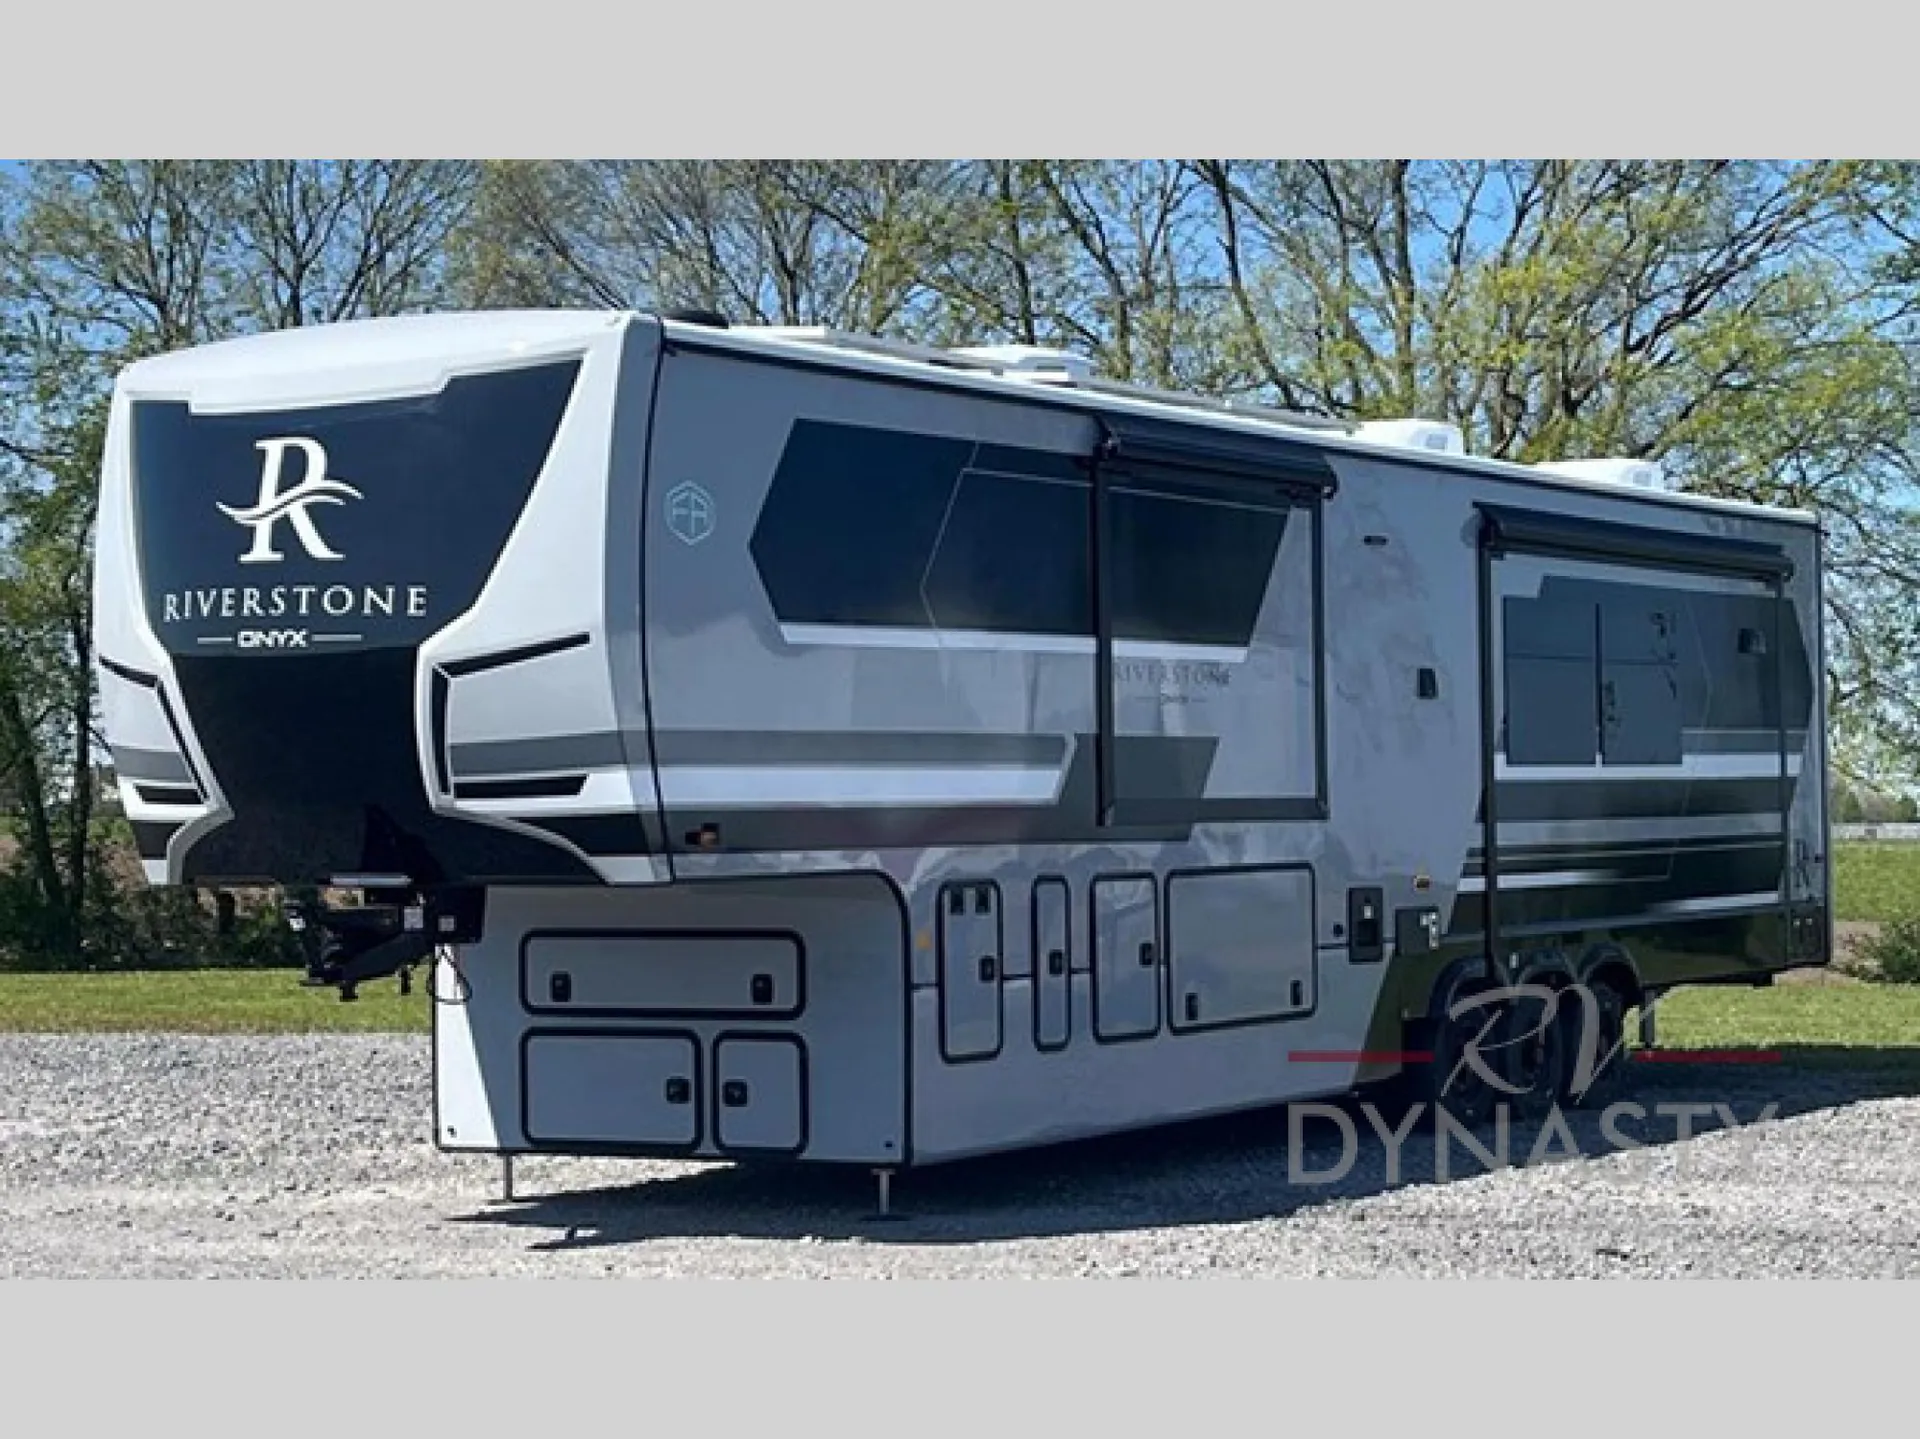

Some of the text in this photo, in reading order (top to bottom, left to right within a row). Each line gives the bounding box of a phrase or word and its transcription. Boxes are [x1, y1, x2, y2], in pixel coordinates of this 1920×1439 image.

[216, 436, 364, 564] R
[162, 584, 428, 624] RIVERSTONE
[237, 628, 308, 648] ONYX
